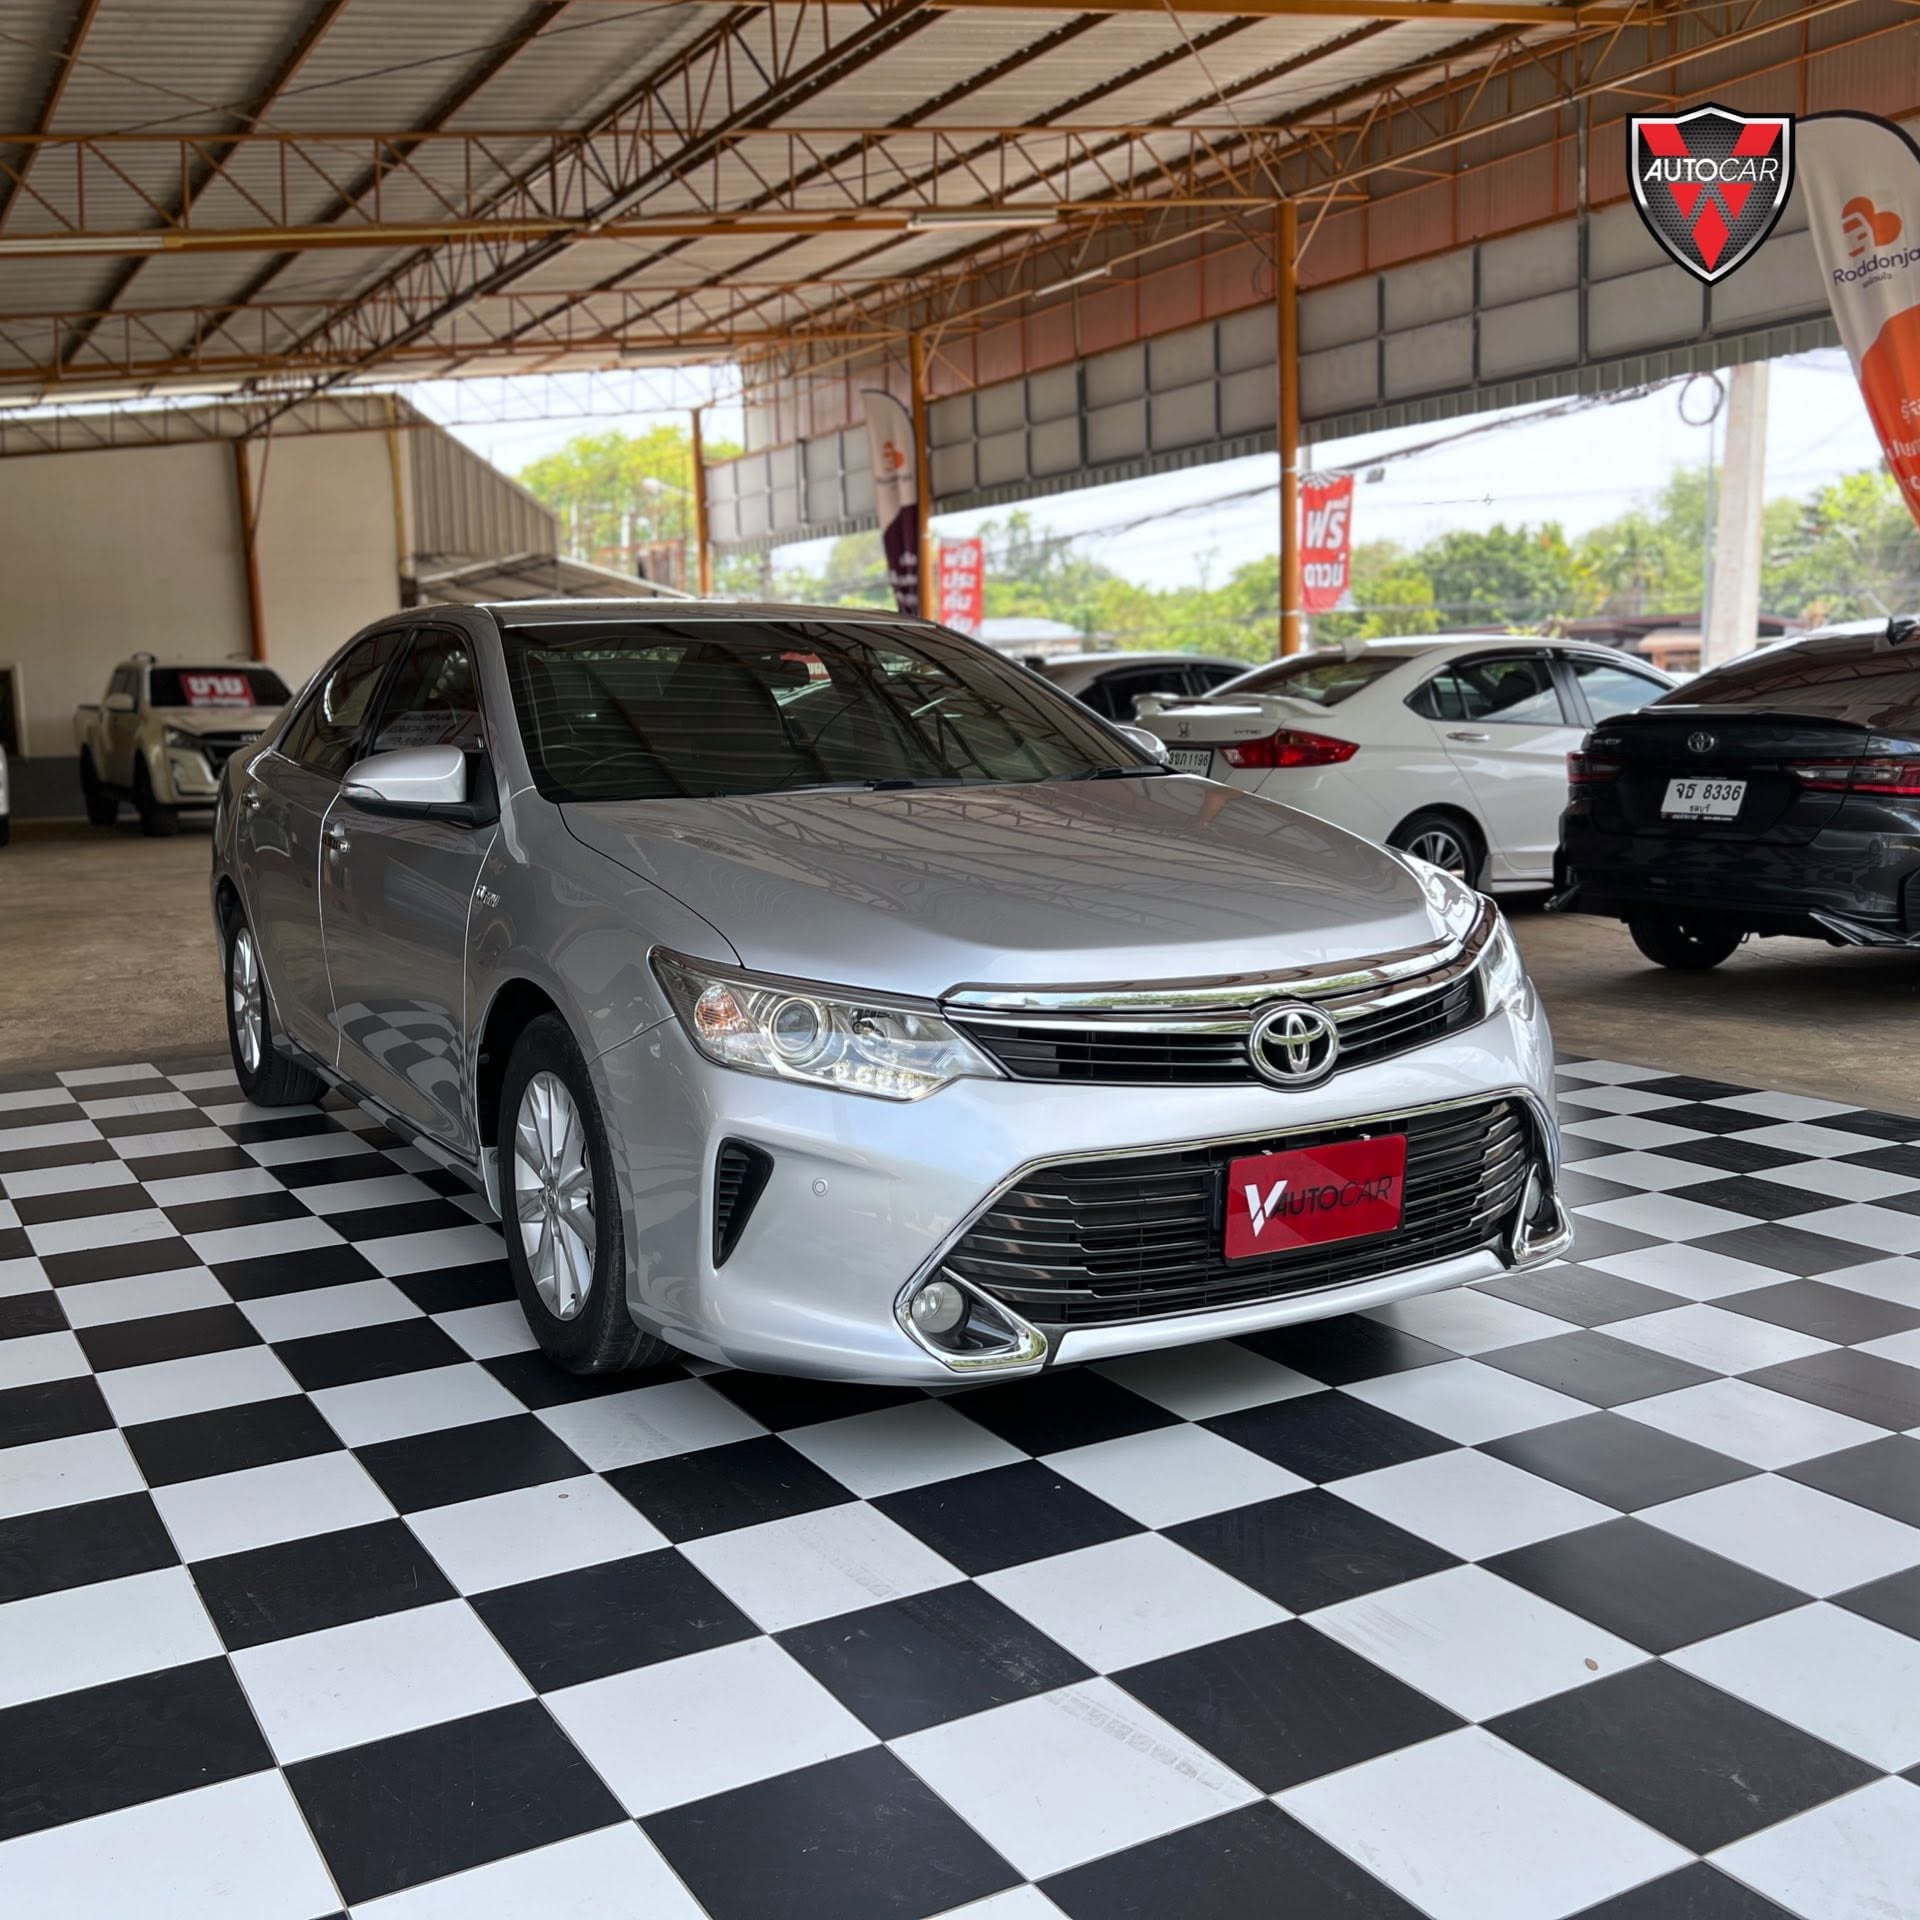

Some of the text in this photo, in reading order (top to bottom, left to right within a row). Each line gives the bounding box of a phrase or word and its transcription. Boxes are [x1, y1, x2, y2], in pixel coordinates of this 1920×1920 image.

[1189, 753, 1209, 767] 1196
[1703, 784, 1742, 801] 8336
[1270, 1175, 1393, 1220] AUTOCAR
